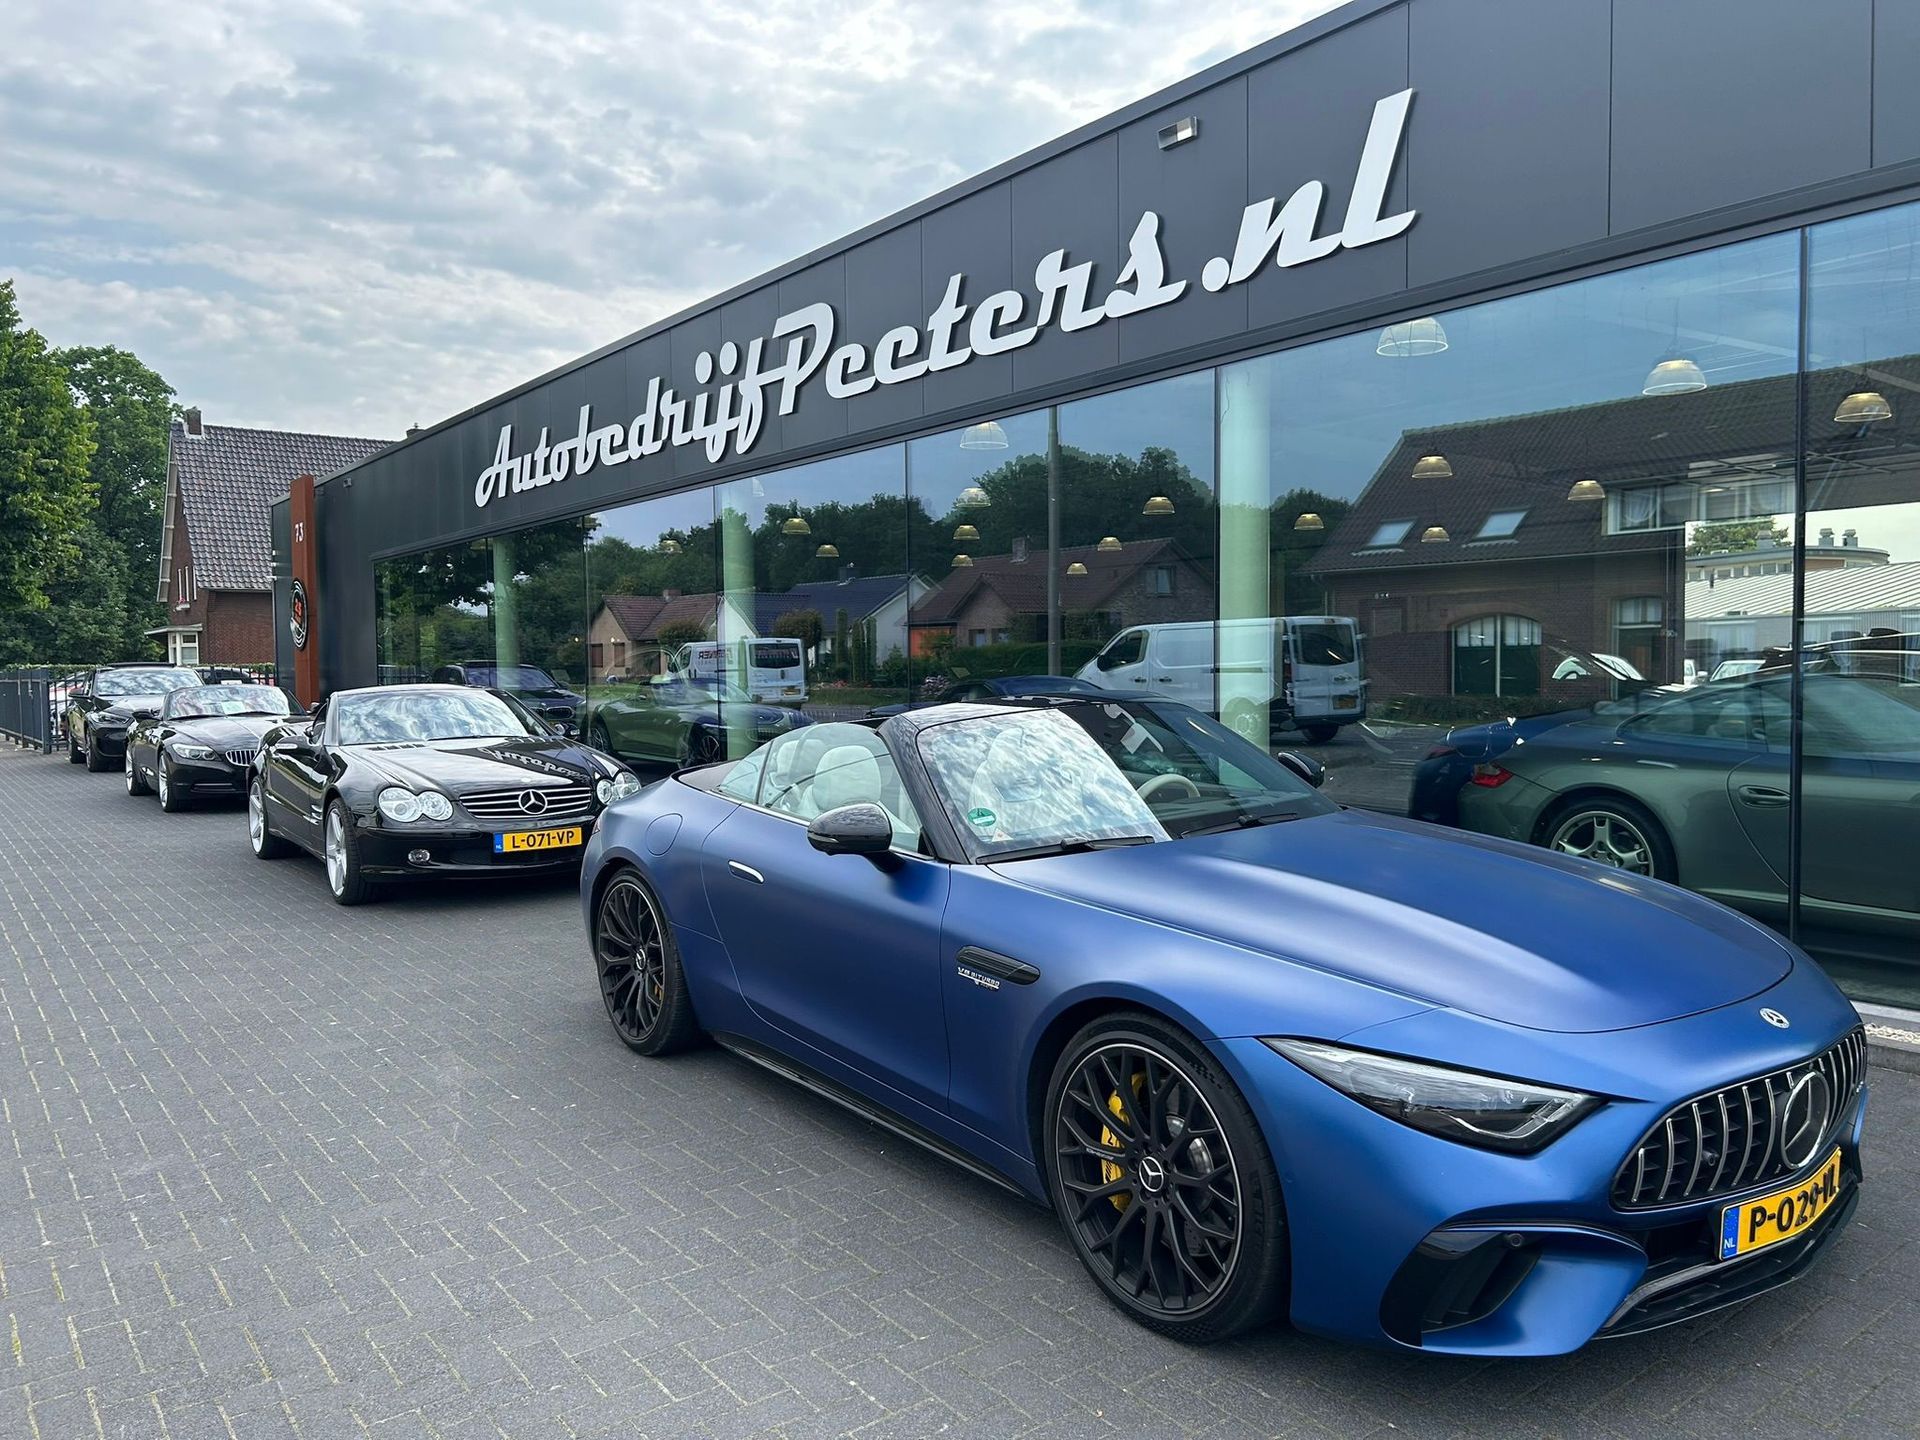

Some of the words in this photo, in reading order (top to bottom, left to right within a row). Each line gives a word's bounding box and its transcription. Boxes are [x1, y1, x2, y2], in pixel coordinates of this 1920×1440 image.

[295, 522, 304, 543] 73
[512, 830, 575, 849] L-071-VP
[970, 971, 1000, 987] BITURBO
[1723, 1237, 1736, 1249] NL
